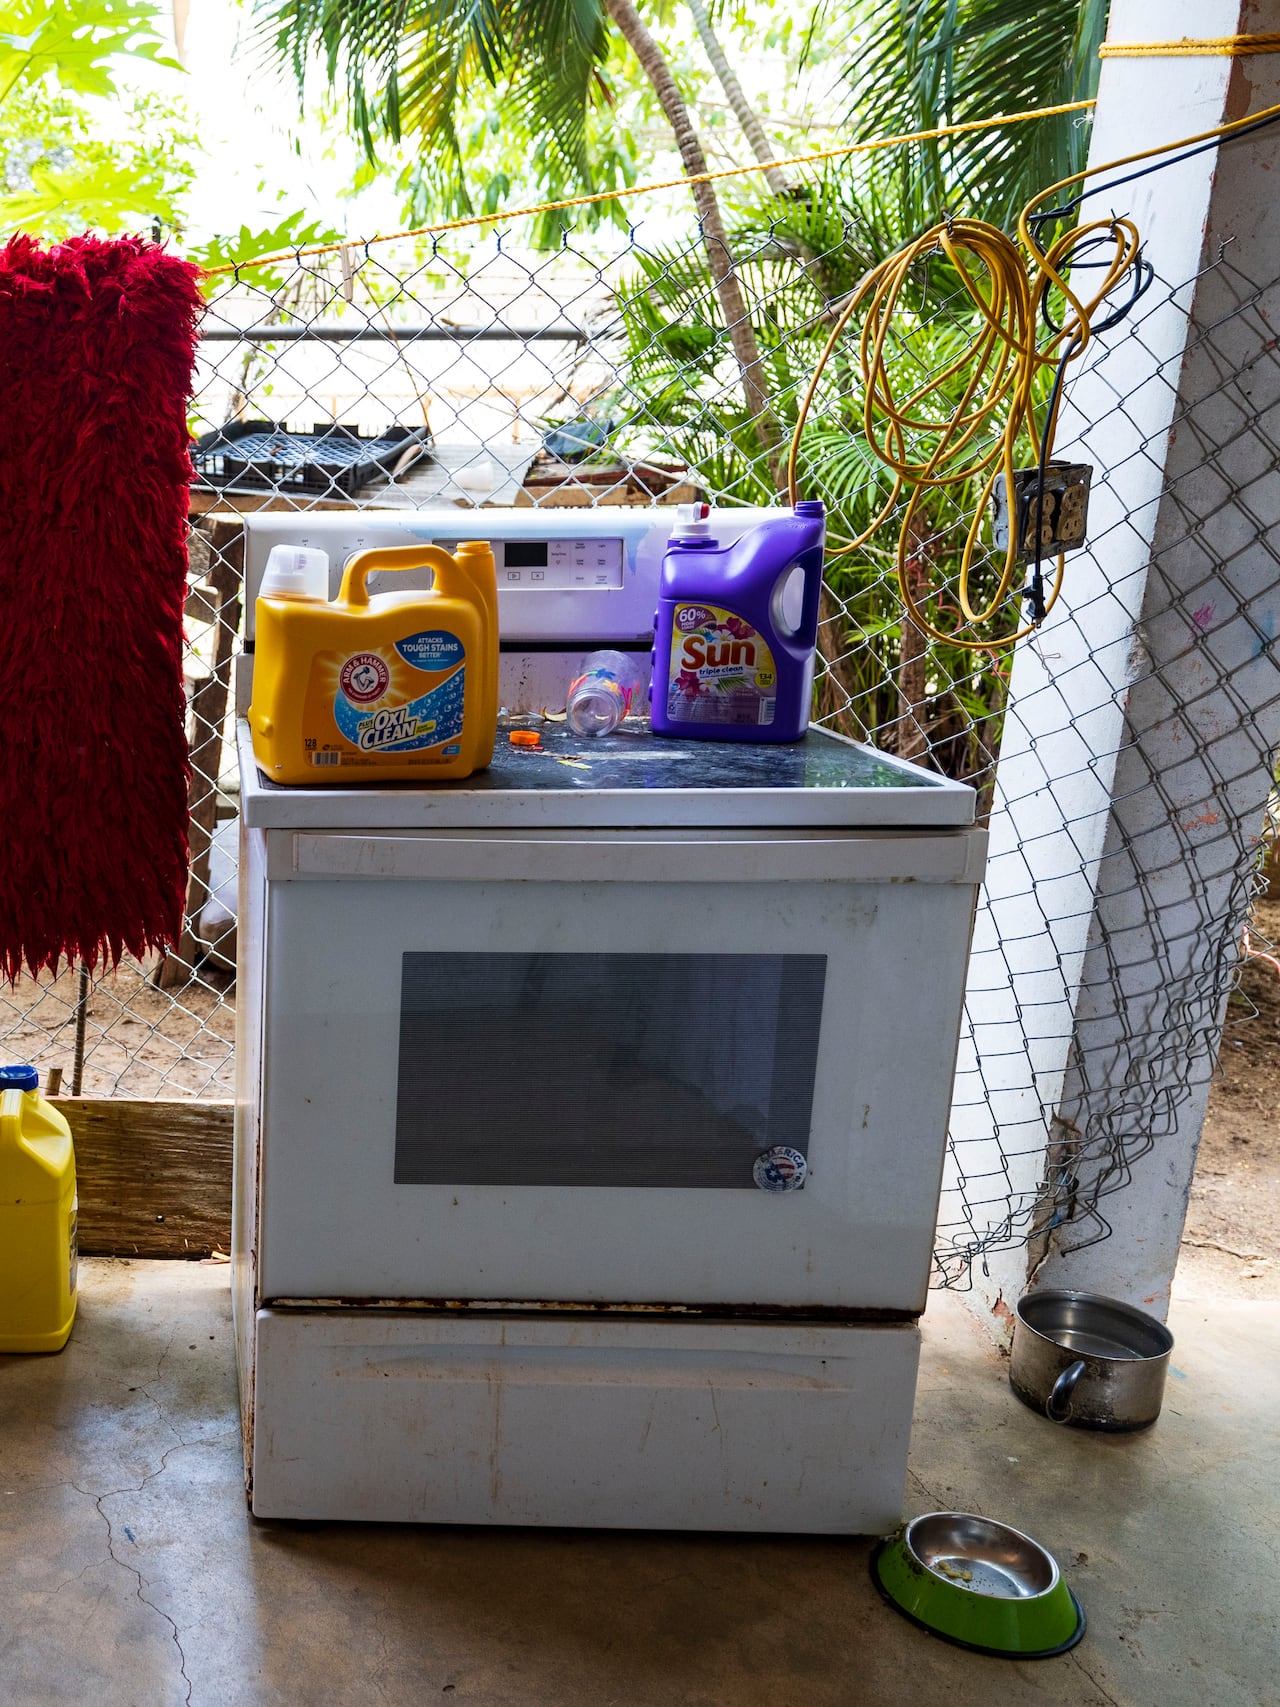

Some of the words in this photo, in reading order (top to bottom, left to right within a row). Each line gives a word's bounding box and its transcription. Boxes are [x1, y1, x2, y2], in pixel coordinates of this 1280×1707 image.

[679, 608, 706, 622] 60%
[402, 644, 430, 652] TOUGH
[430, 643, 458, 651] STAINS
[681, 635, 756, 671] Sun
[343, 663, 355, 683] ARM
[352, 659, 360, 667] &
[360, 656, 386, 683] HAMMER
[699, 667, 721, 676] triple
[721, 665, 744, 673] clean
[374, 709, 407, 731] OXI
[304, 738, 317, 747] 128
[361, 719, 417, 750] CLEAN
